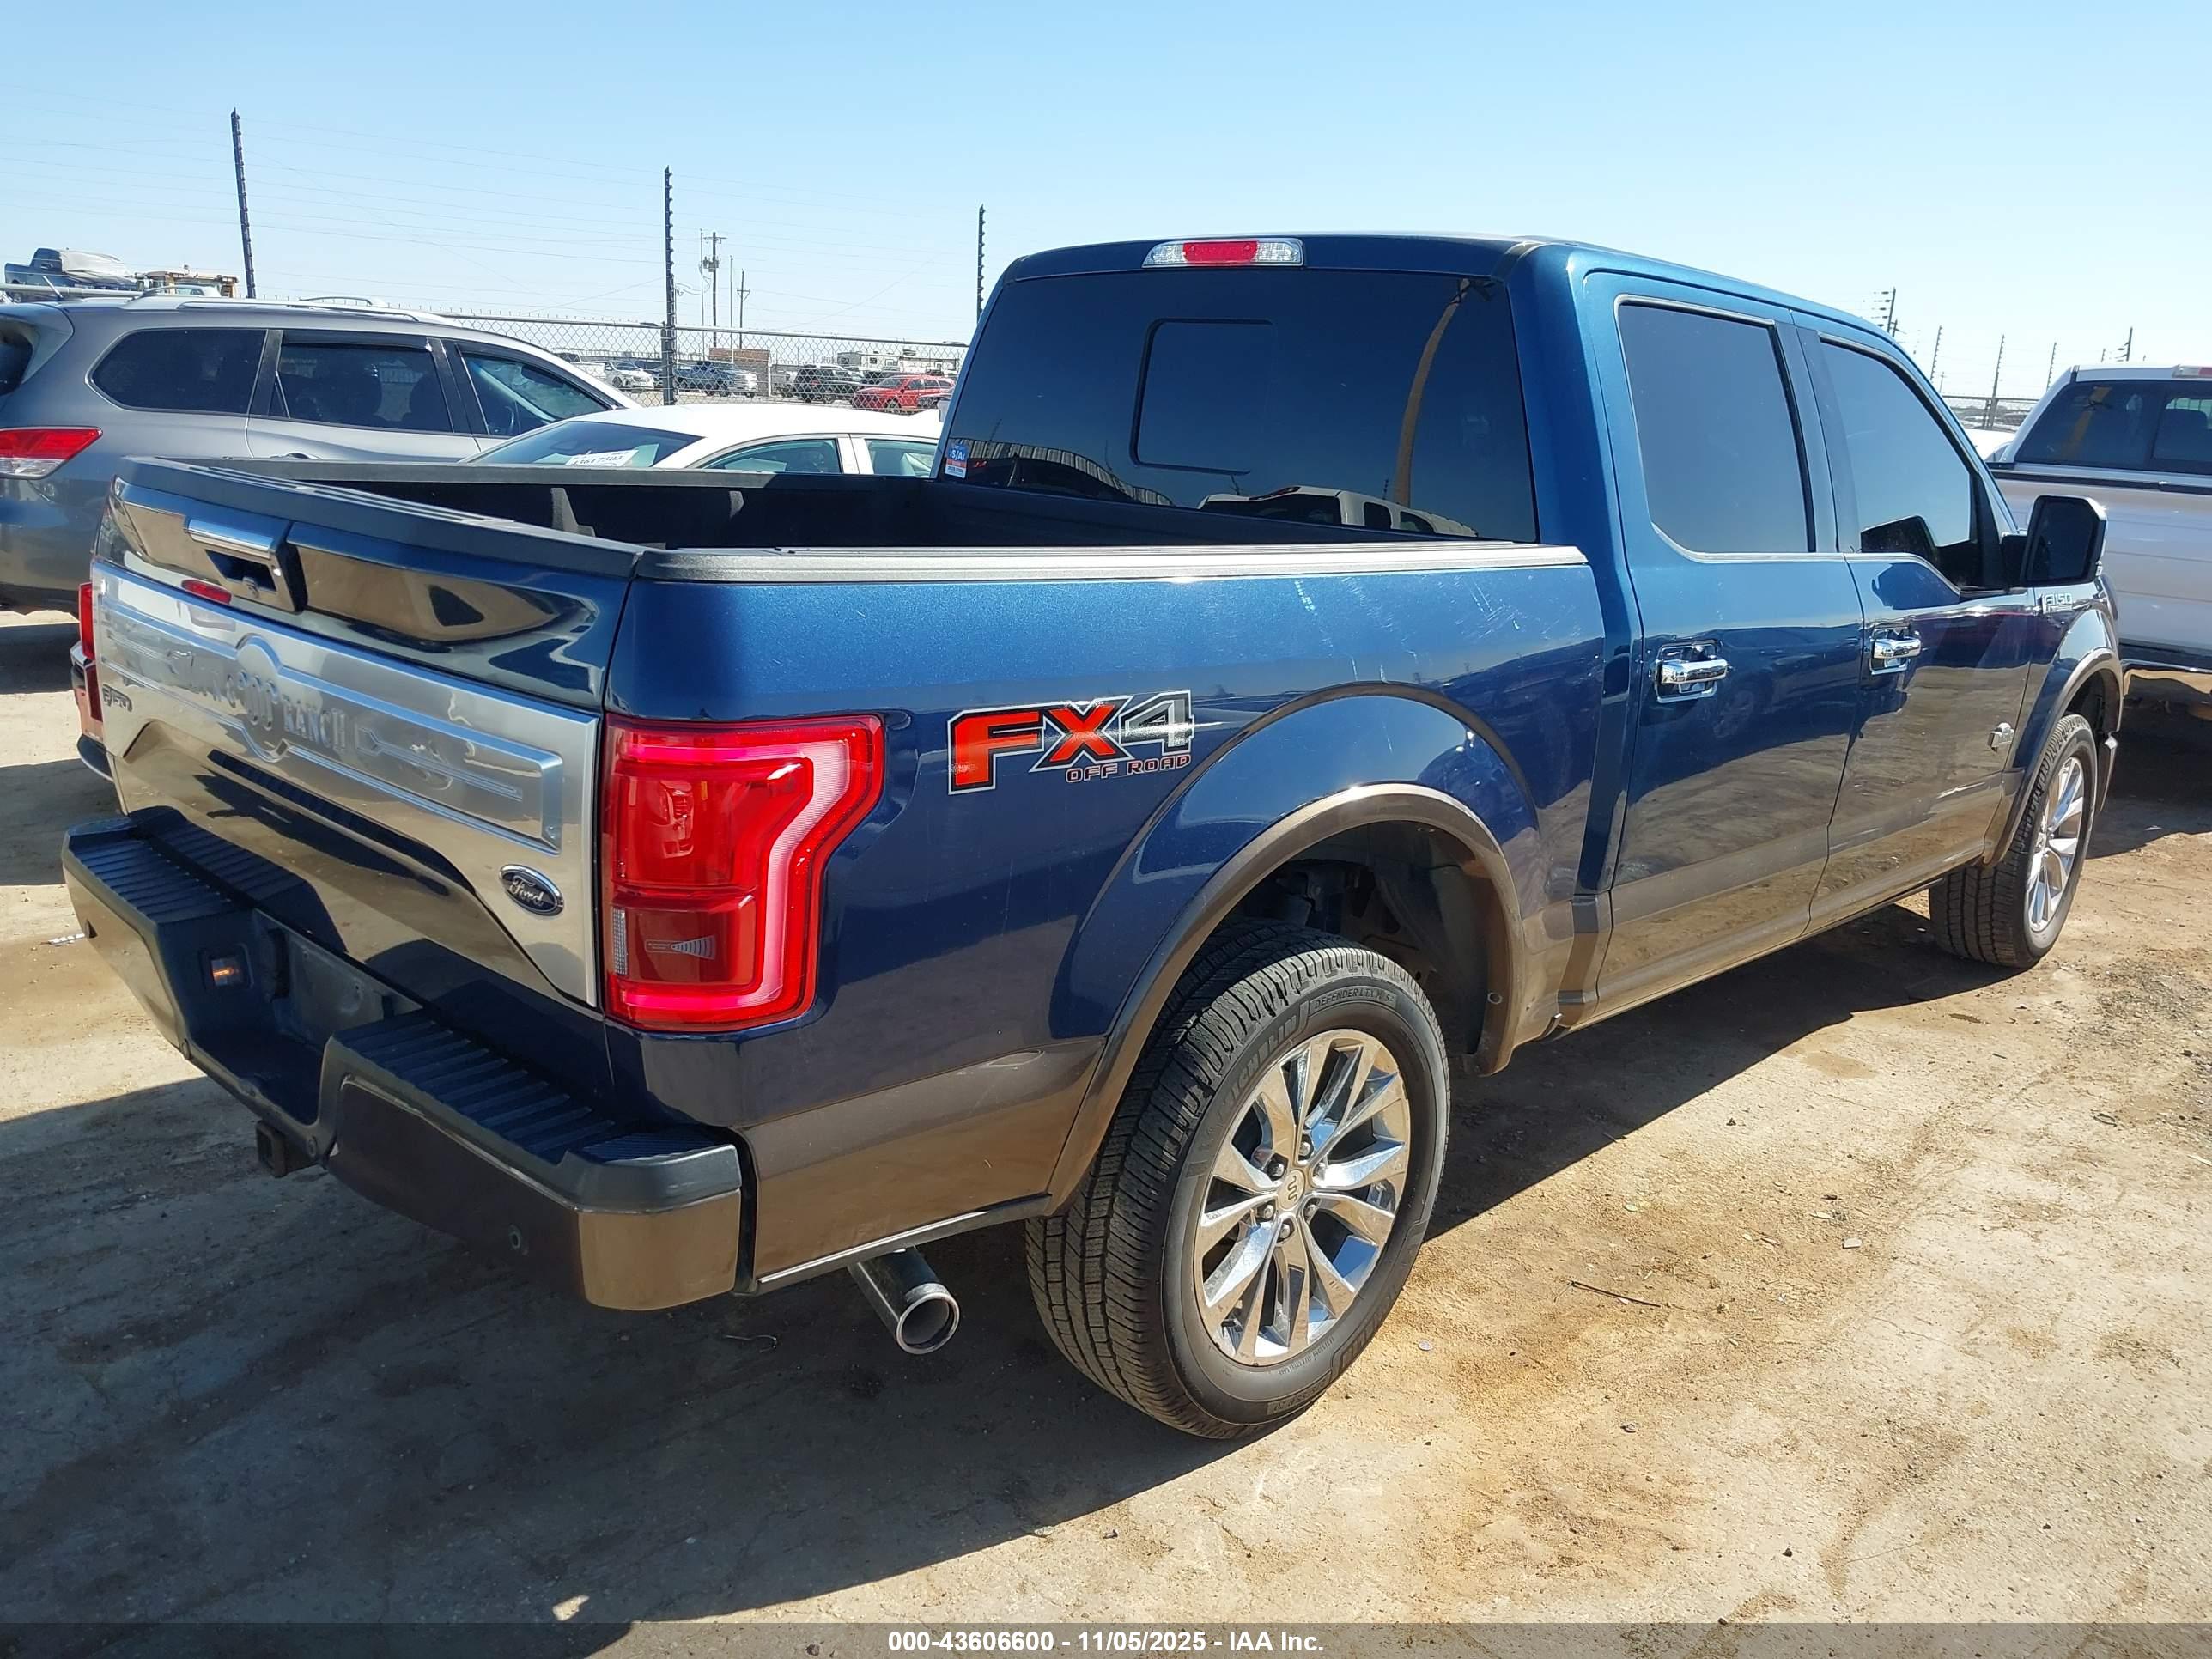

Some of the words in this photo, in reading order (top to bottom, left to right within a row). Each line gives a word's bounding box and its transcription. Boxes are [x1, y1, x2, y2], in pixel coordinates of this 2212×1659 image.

[283, 694, 346, 750] RANCH
[948, 690, 1195, 795] FX4
[1066, 763, 1118, 783] OFF
[1126, 754, 1192, 776] ROAD
[509, 874, 544, 907] Ford
[1314, 988, 1358, 1009] DEFENDER
